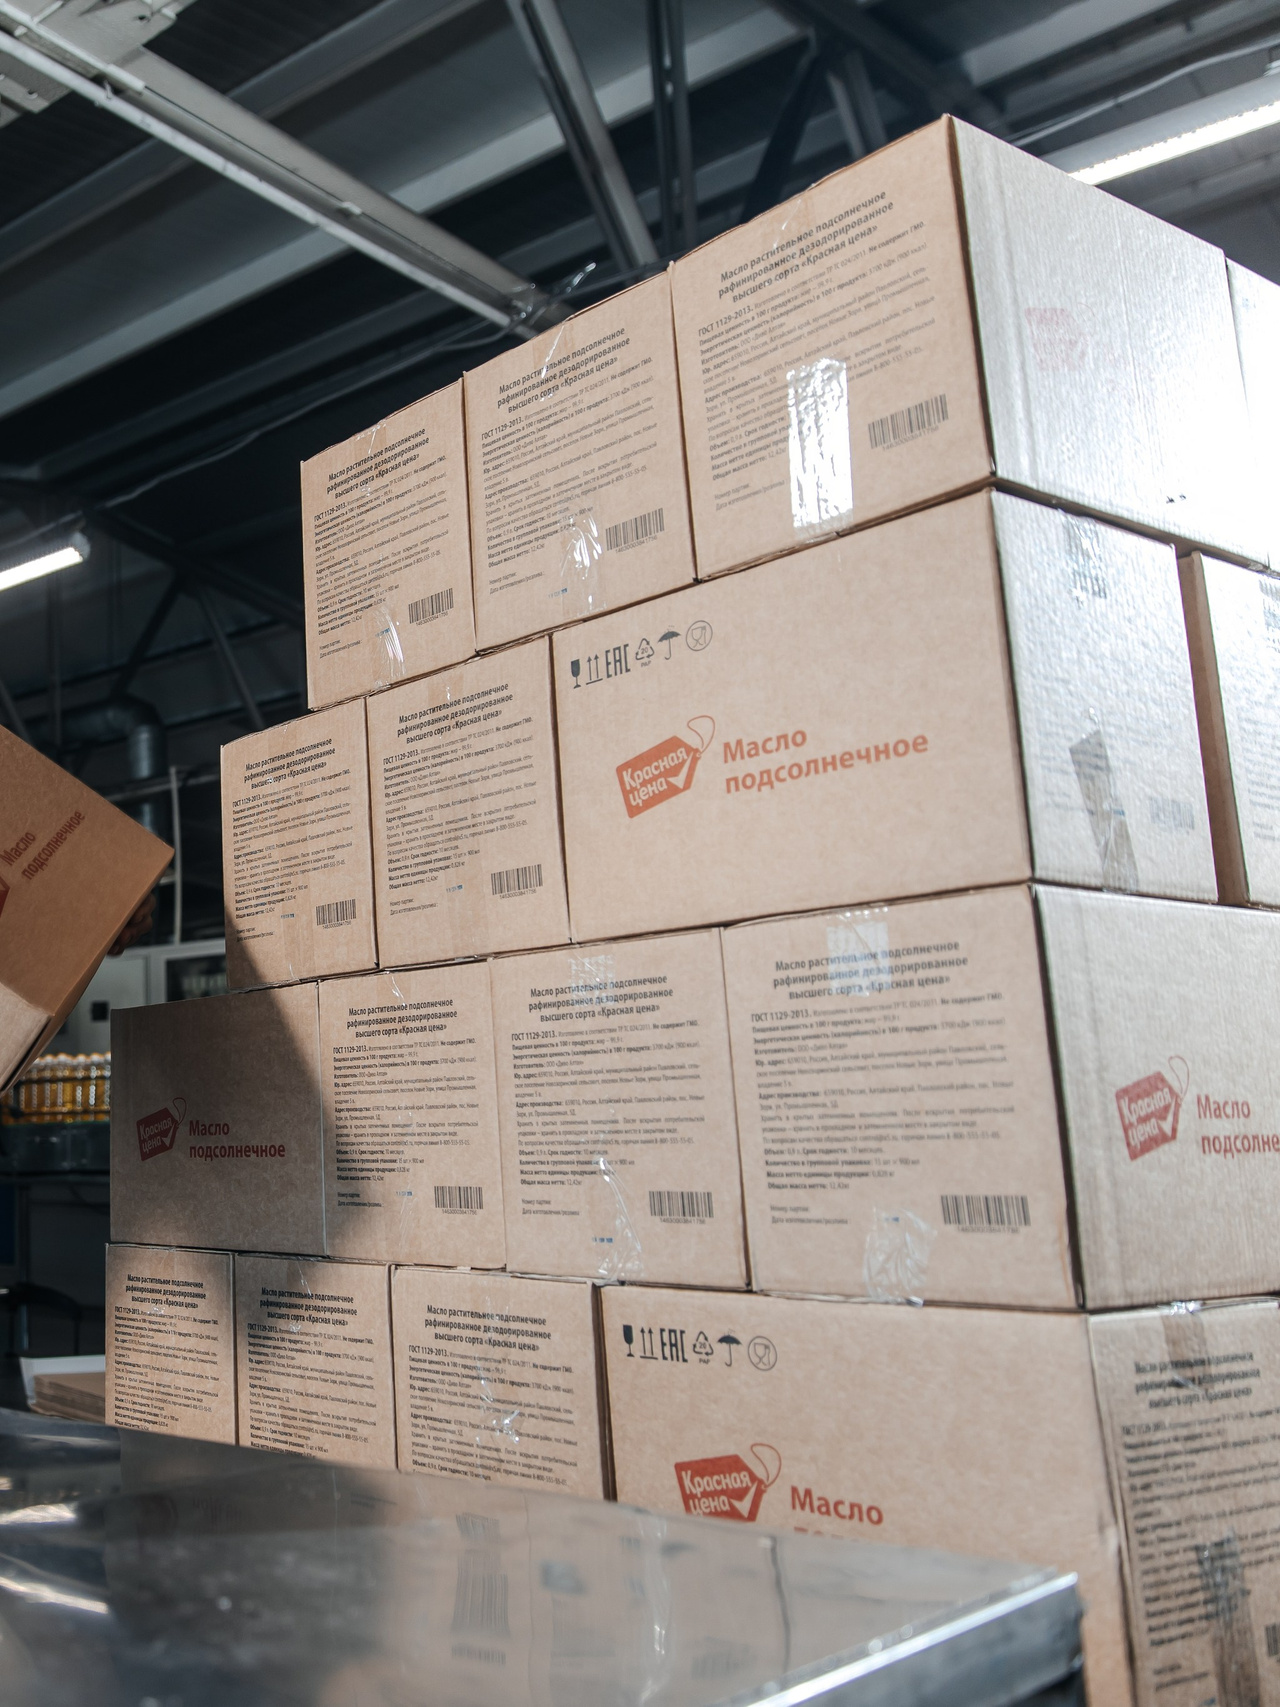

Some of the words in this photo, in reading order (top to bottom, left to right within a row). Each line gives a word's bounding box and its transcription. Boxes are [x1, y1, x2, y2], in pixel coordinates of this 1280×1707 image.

[497, 372, 558, 409] рафинированное
[558, 337, 630, 379] дезодорированное
[499, 378, 521, 395] Масло
[521, 354, 571, 386] растиельное
[571, 328, 625, 359] подсолнечное
[508, 393, 539, 414] высшего
[539, 383, 560, 399] сорта
[560, 367, 594, 388] «Красная
[595, 357, 618, 372] цена»
[329, 469, 345, 482] Масло
[346, 449, 384, 475] растительное
[384, 428, 425, 454] подсолнечное
[335, 483, 359, 499] высшего
[359, 475, 375, 487] сорта
[375, 462, 401, 478] «Красная
[402, 454, 419, 466] цена»
[397, 713, 450, 738] рафинированное
[450, 694, 513, 721] дезодорированное
[399, 712, 418, 724] Масло
[418, 698, 461, 720] растительное
[462, 683, 508, 704] подсолнечное
[406, 730, 433, 744] высшего
[434, 725, 451, 736] сорта
[452, 715, 482, 730] «Красная
[482, 710, 502, 721] цена»
[383, 755, 394, 765] ГОСТ
[723, 729, 807, 763] Масло
[622, 746, 688, 790] Красная
[725, 734, 929, 794] подсолнечное
[629, 777, 669, 807] цена
[0, 831, 36, 866] Масло
[21, 810, 86, 880] подсолнечное
[530, 988, 554, 998] Масло
[347, 1016, 397, 1030] рафинированное
[397, 1011, 457, 1024] дезодорированное
[348, 1008, 367, 1016] Масло
[367, 1004, 408, 1017] растительное
[409, 999, 453, 1010] подсолнечное
[540, 1012, 574, 1023] высшего
[574, 1010, 596, 1021] сорта
[597, 1006, 634, 1019] «Красная
[635, 1004, 660, 1015] цена»
[355, 1030, 381, 1038] высшего
[381, 1028, 398, 1037] сорта
[399, 1025, 427, 1036] «Красная
[428, 1024, 447, 1033] цена»
[333, 1046, 343, 1054] ГОСТ
[1121, 1087, 1171, 1125] Красная
[1197, 1094, 1251, 1119] Масло
[140, 1117, 172, 1140] Красная
[189, 1120, 230, 1136] Масло
[1128, 1117, 1160, 1149] цена
[142, 1137, 162, 1154] цена
[189, 1144, 285, 1161] подсолнечное
[424, 1318, 482, 1333] рафинированное
[426, 1304, 447, 1316] Масло
[448, 1309, 495, 1321] растительное
[434, 1332, 464, 1343] высшего
[464, 1336, 484, 1346] сорта
[484, 1336, 517, 1349] «Красная
[518, 1342, 540, 1352] цена»
[681, 1470, 752, 1496] Красная
[689, 1495, 731, 1515] цена
[790, 1485, 884, 1525] Масло
